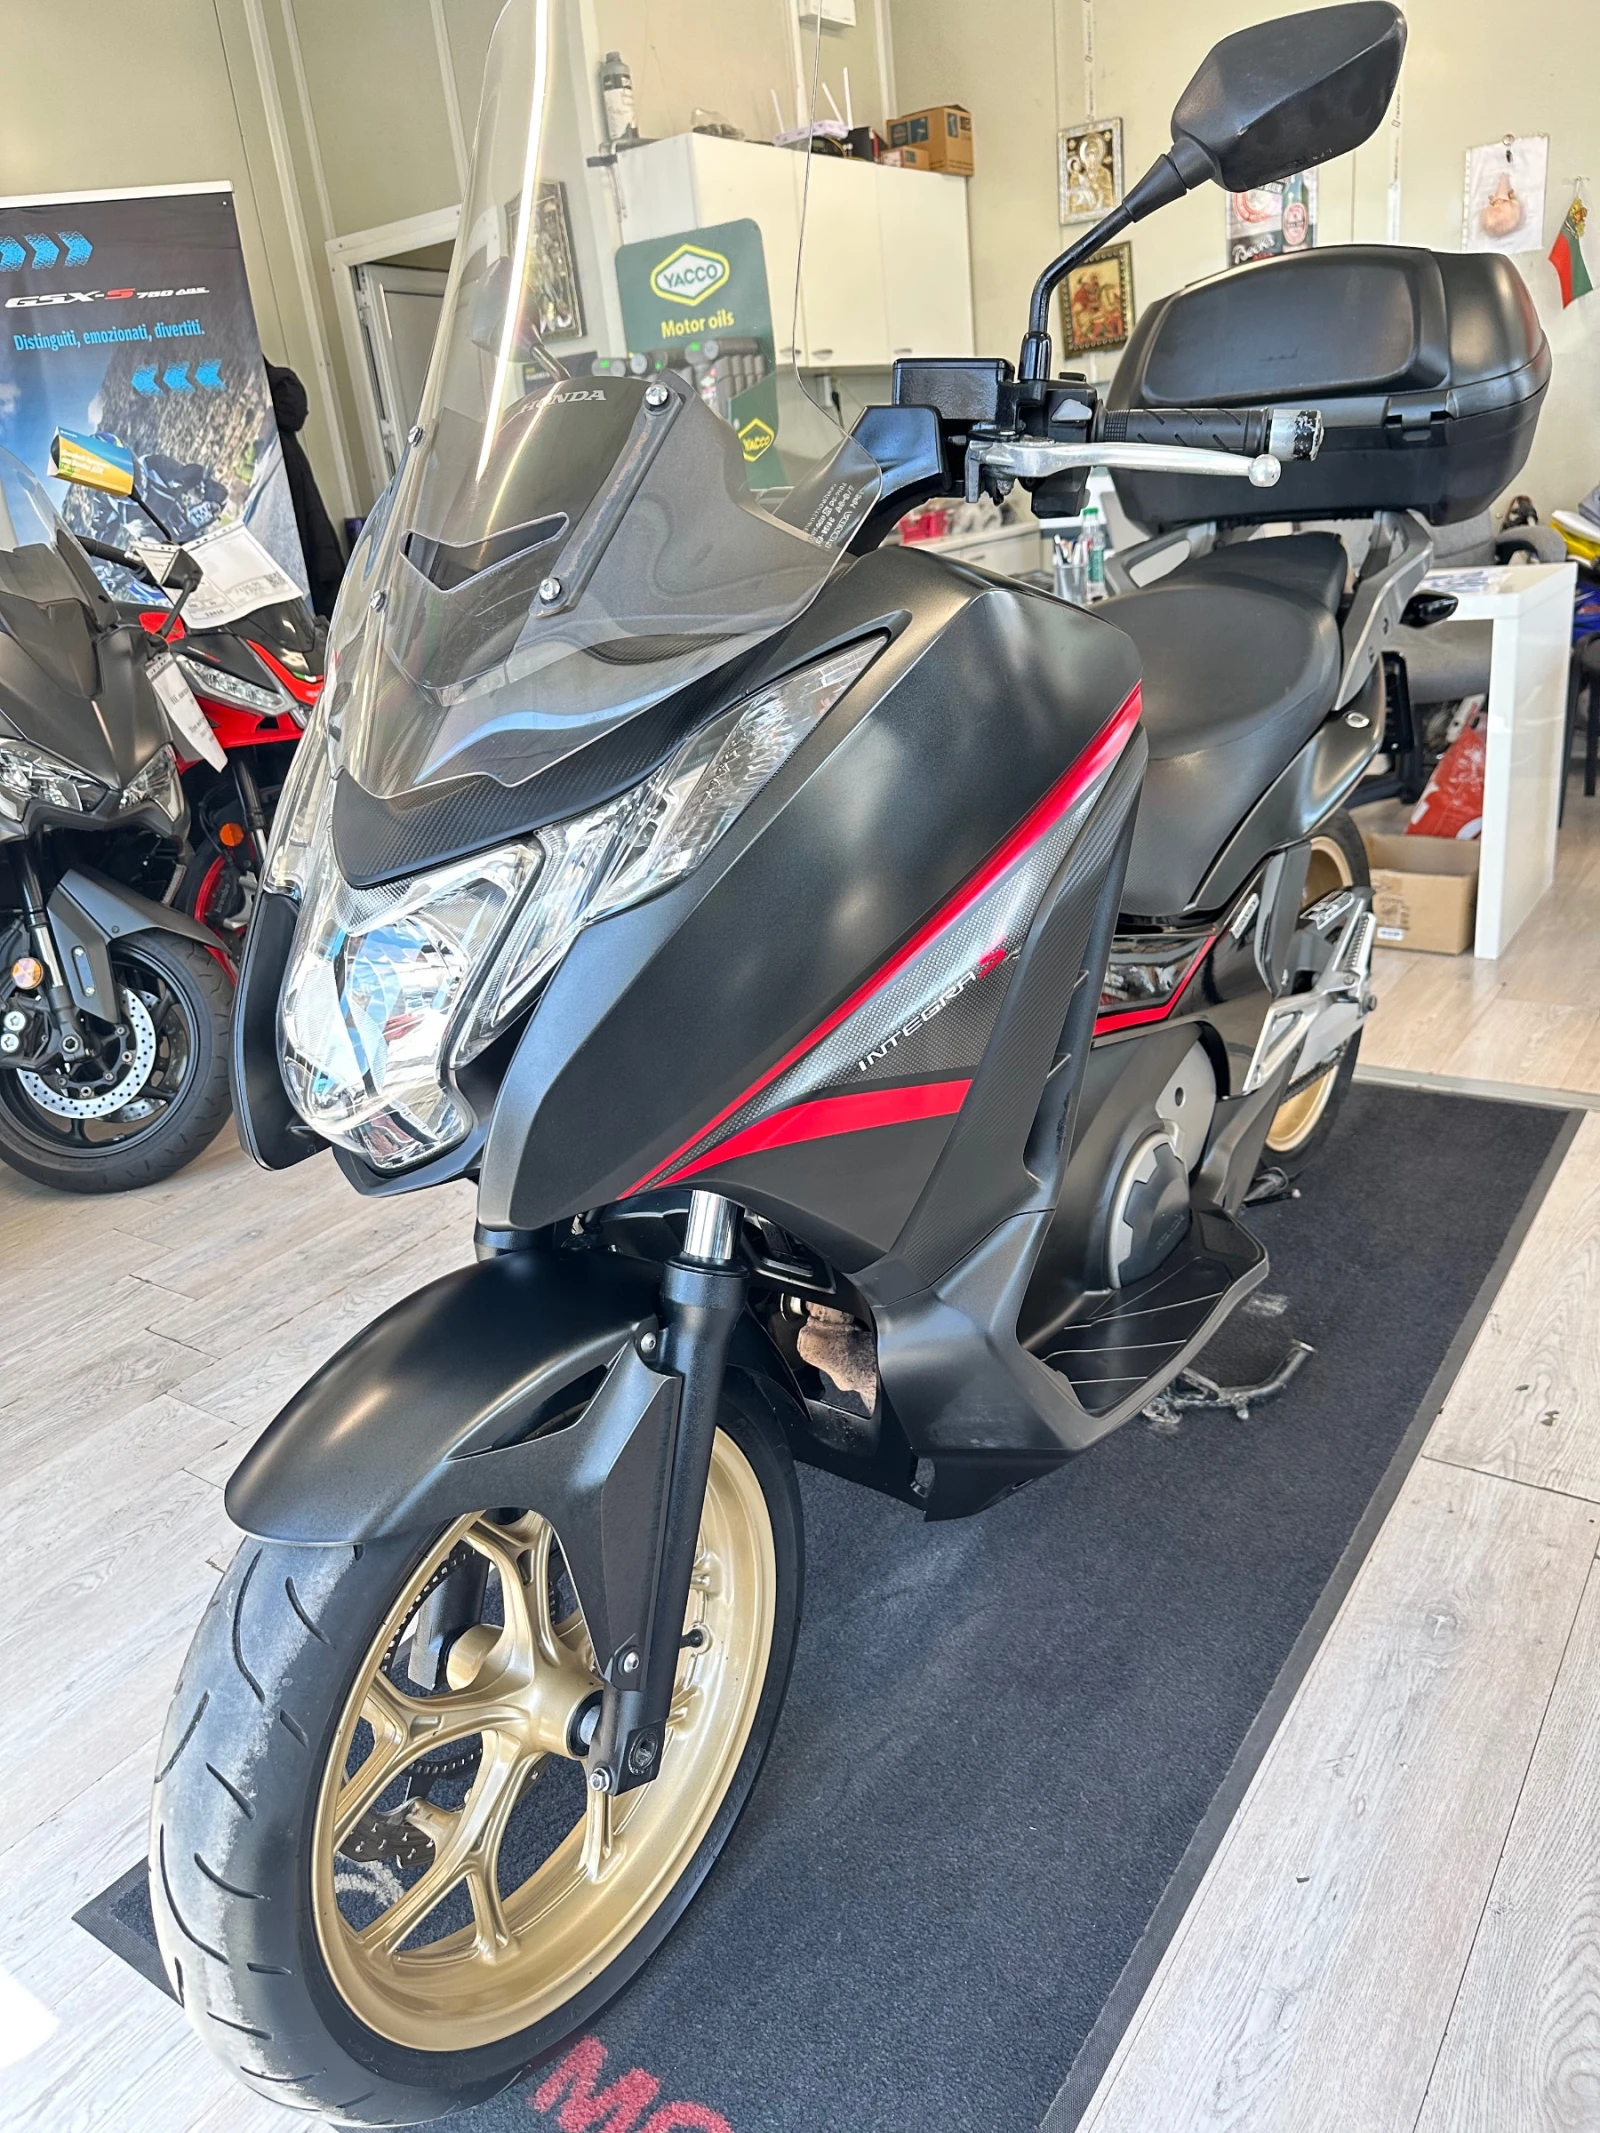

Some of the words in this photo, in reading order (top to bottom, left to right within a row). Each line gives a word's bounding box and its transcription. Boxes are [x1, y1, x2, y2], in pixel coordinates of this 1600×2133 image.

[663, 263, 718, 288] YACCO
[4, 286, 136, 308] GSX-S
[13, 329, 81, 351] Distinguiti,
[83, 322, 153, 345] emozionati,
[154, 318, 206, 338] divertiti.
[660, 317, 706, 340] Motor
[707, 308, 735, 330] oils
[858, 971, 977, 1072] INTEGRA
